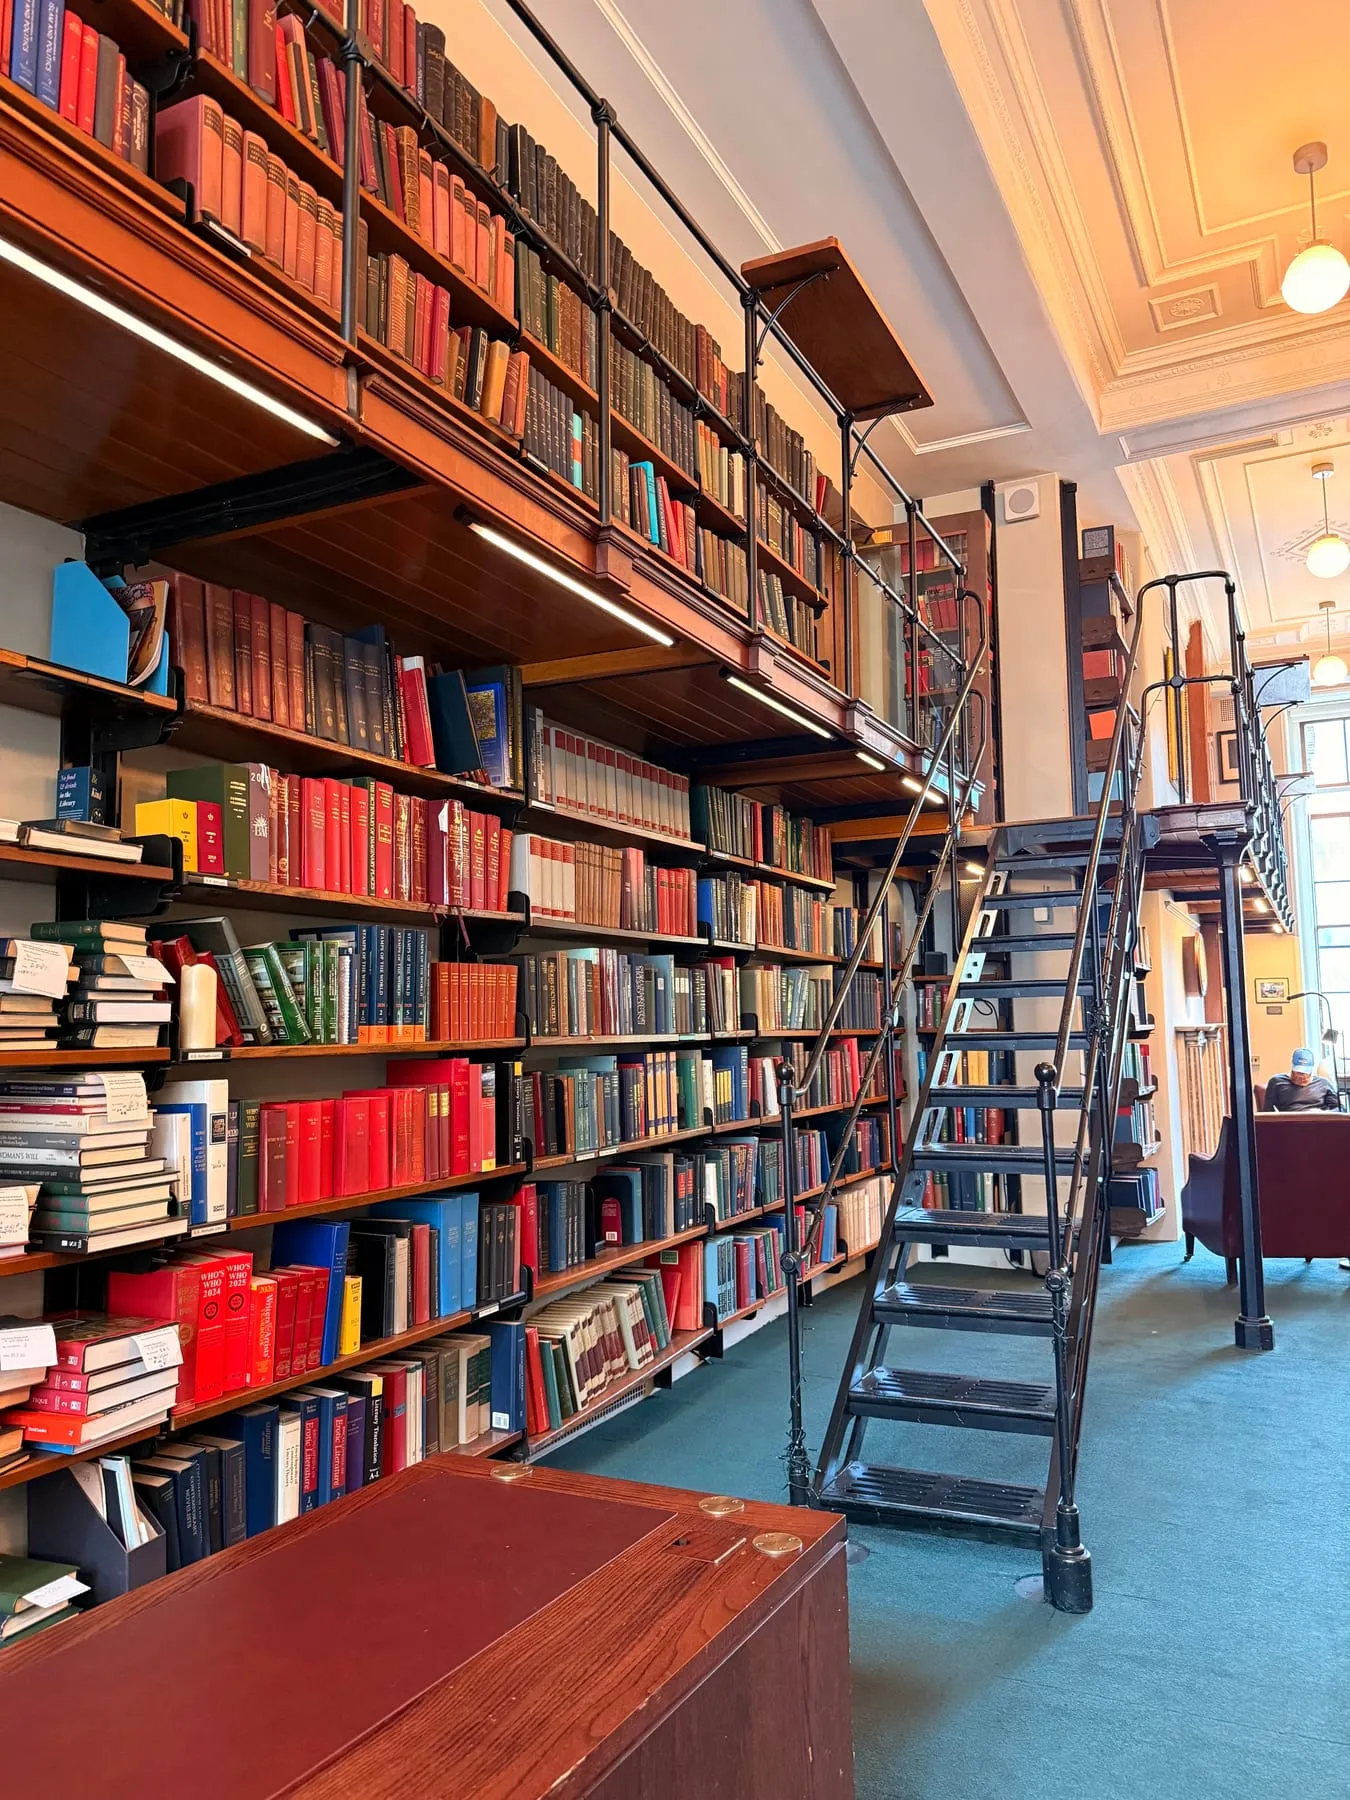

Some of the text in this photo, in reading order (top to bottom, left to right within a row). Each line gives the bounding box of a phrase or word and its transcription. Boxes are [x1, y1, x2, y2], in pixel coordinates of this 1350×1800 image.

[45, 40, 53, 72] POLITICS
[91, 787, 102, 800] Kind
[226, 1263, 251, 1272] WHO'S
[201, 1270, 224, 1281] WHO'S
[203, 1279, 222, 1288] WHO
[228, 1279, 246, 1288] 2025
[203, 1288, 221, 1298] 2024
[304, 1422, 313, 1490] Erotic Literature
